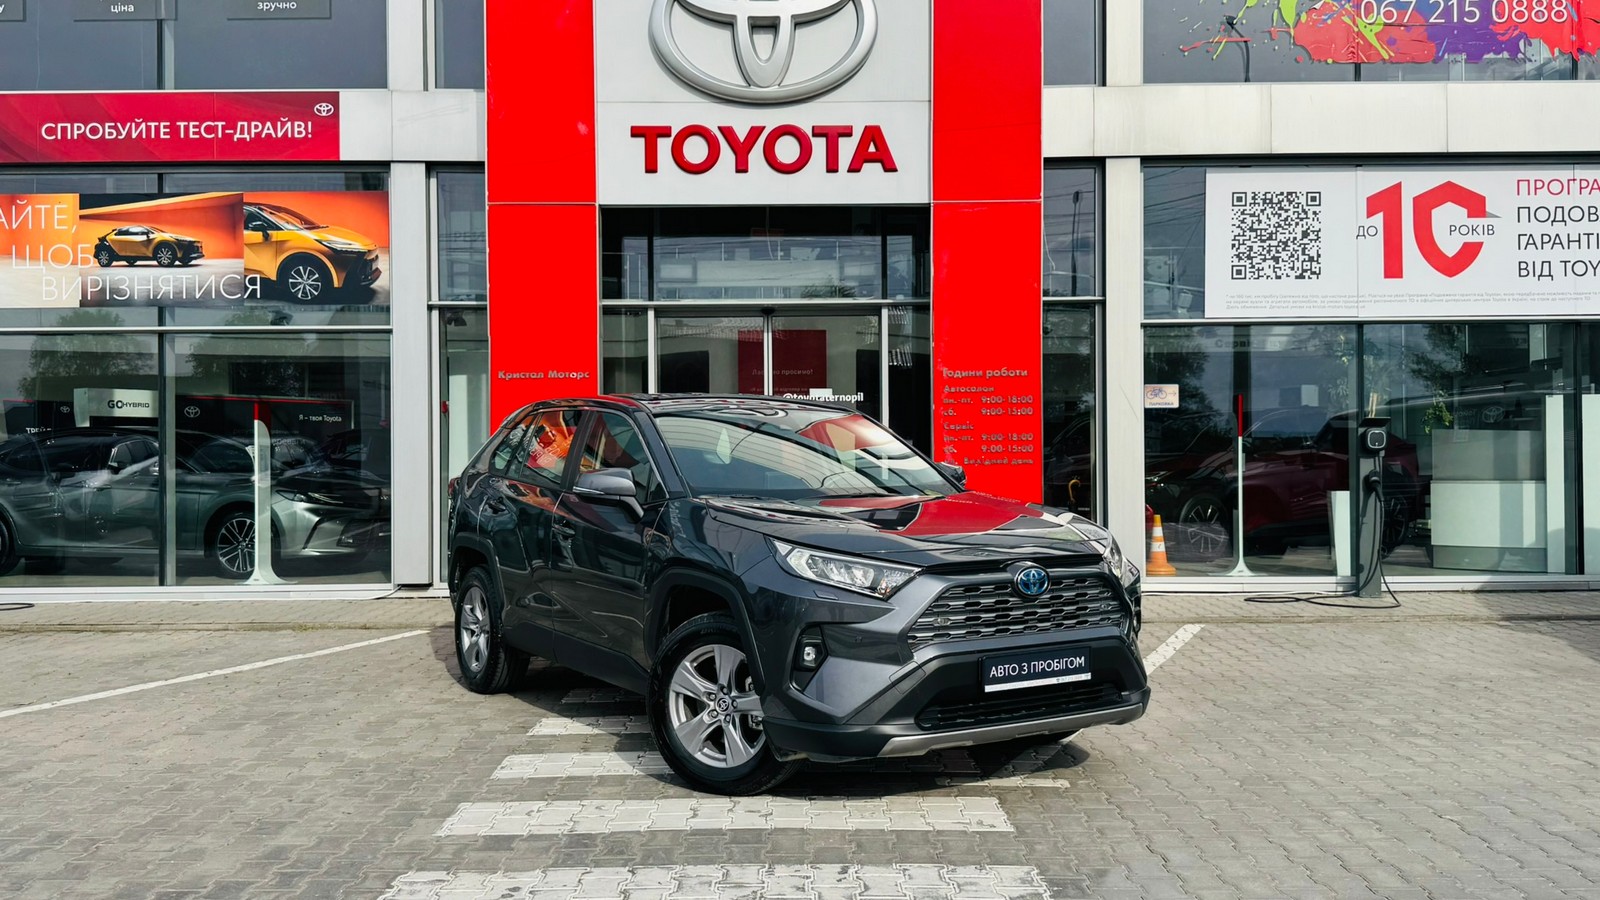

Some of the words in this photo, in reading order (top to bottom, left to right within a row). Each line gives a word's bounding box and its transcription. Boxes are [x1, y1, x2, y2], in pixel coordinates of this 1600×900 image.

[111, 3, 135, 13] ціна
[257, 1, 297, 11] зручно
[1360, 0, 1416, 23] 067
[1428, 0, 1480, 23] 215
[1491, 0, 1568, 23] 0888
[41, 118, 171, 140] СПРОБУЙТЕ
[176, 117, 313, 141] ТЕСТ-ДРАЙВ!
[630, 123, 899, 175] TOYOTA
[1516, 178, 1600, 196] ПРОГРА
[1517, 205, 1600, 226] ПОДОВ
[1356, 225, 1378, 239] ДО
[1449, 224, 1495, 236] РОКІВ
[1517, 232, 1599, 251] ГАРАНТІ
[12, 244, 95, 270] ЩОБ
[1518, 260, 1554, 281] ВІД
[42, 273, 261, 301] ВИРІЗНЯТИСЯ
[498, 371, 544, 381] Кристал
[548, 370, 590, 380] Моторс
[942, 368, 983, 379] Години
[986, 367, 1028, 379] роботи
[944, 385, 994, 393] Автосалон
[323, 415, 342, 423] Toyota
[989, 664, 1019, 678] АВТО
[1021, 662, 1028, 674] З
[1031, 656, 1085, 673] ПРОБІГОМ
